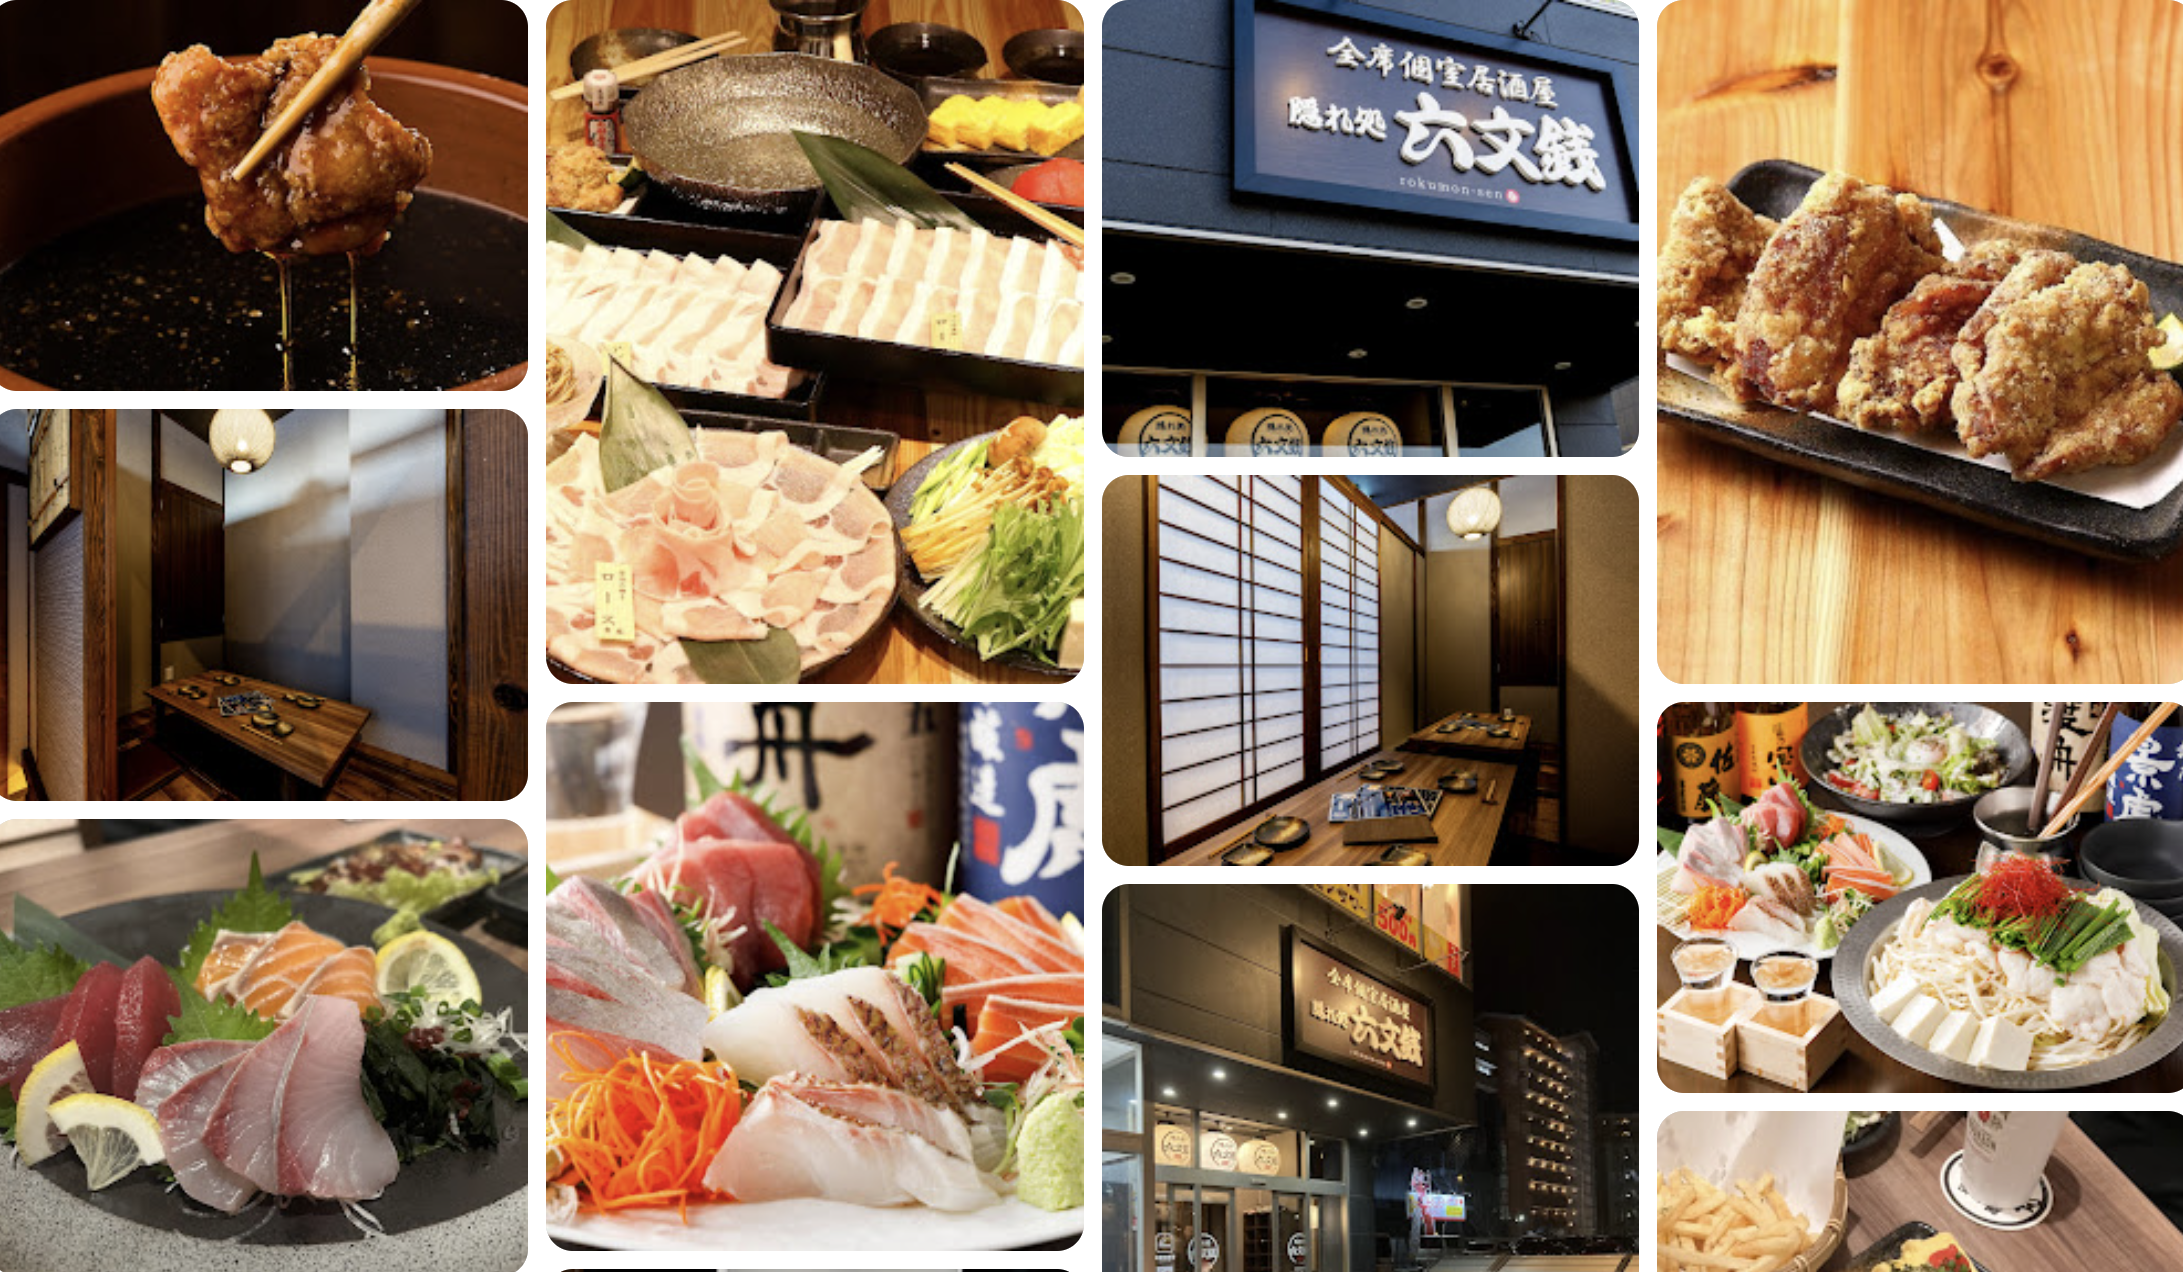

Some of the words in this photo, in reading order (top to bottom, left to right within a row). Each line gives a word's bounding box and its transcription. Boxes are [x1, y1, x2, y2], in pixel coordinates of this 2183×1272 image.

[1326, 36, 1559, 108] 全席個室居酒屋
[1288, 95, 1388, 140] 隠れ処
[1399, 175, 1503, 200] rokumon-sen
